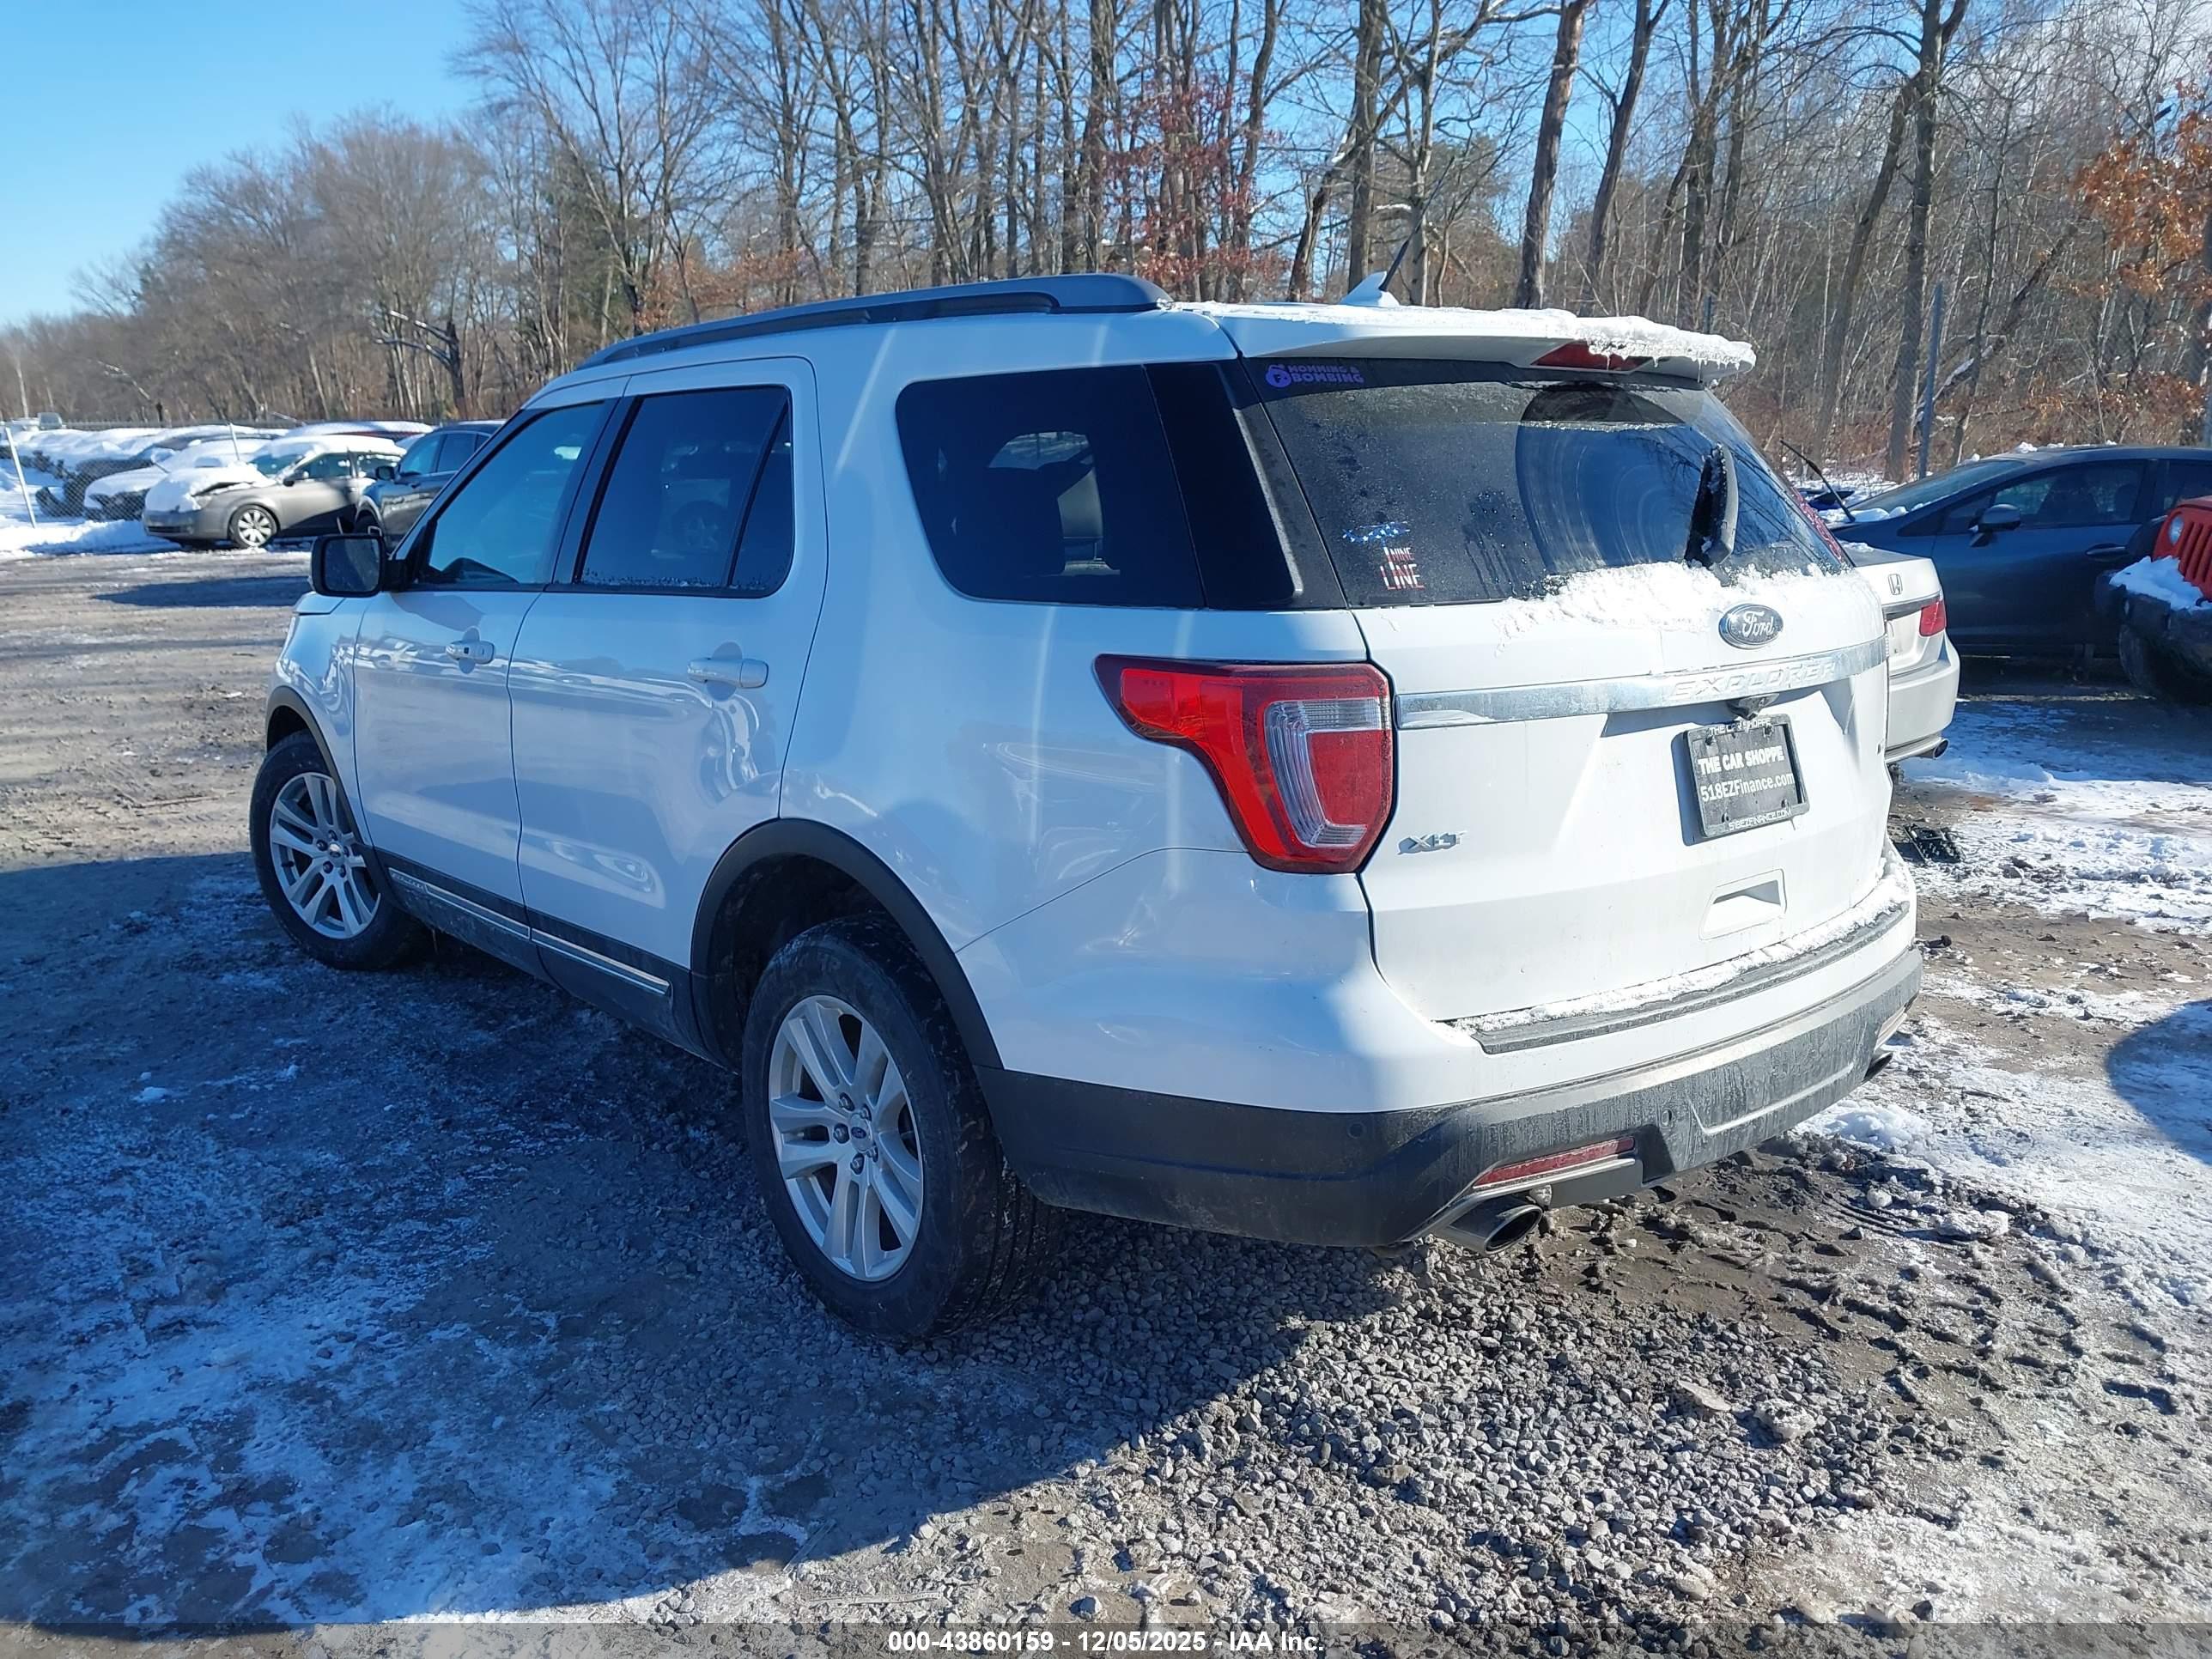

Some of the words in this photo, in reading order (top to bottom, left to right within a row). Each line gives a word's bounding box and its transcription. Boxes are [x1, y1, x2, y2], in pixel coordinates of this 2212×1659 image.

[1291, 373, 1364, 383] BOMBING
[1379, 563, 1425, 590] LINE
[1741, 611, 1775, 637] Ford
[1673, 662, 1835, 696] EXPLORER
[1698, 756, 1722, 775] THE
[1722, 752, 1745, 771] CAR
[1744, 745, 1784, 767] SHOPPE
[1700, 773, 1795, 802] 518EZFinance.com
[1397, 832, 1465, 854] XLT
